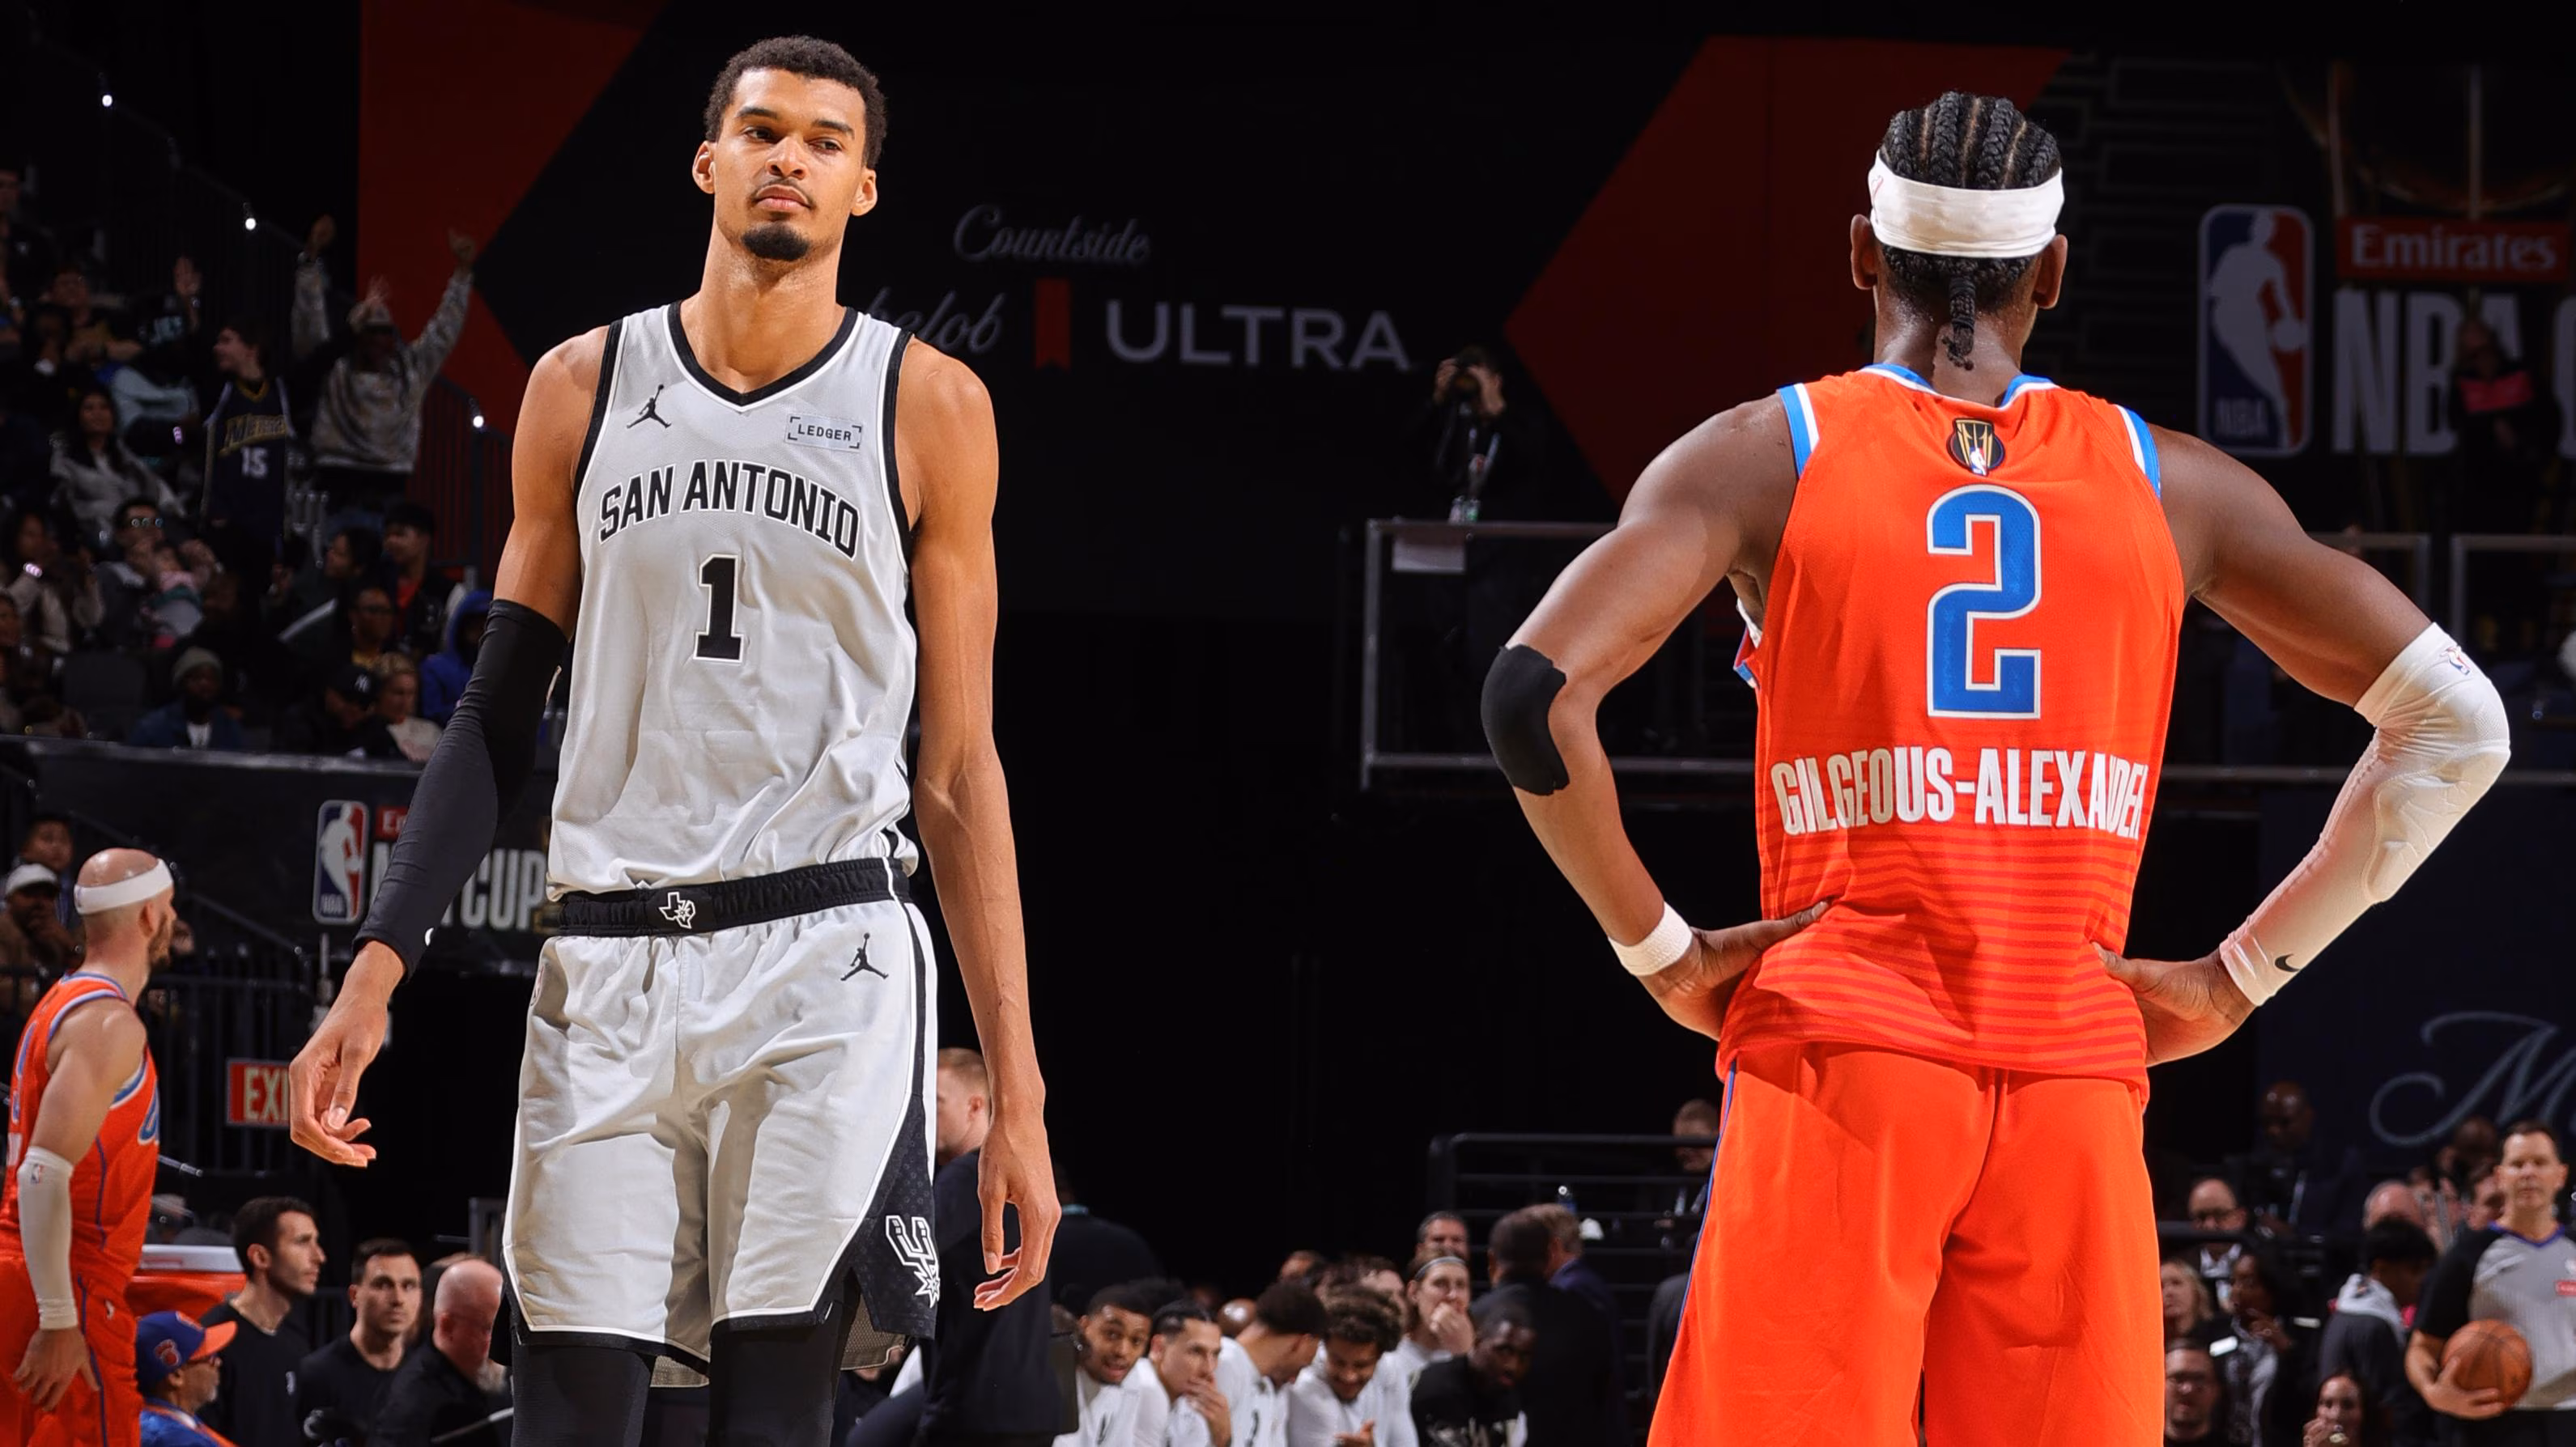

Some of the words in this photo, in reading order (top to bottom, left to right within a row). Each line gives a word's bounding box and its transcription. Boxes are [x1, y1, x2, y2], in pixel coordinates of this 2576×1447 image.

[953, 202, 1152, 265] Courtside
[2350, 223, 2558, 273] Emirates
[1105, 298, 1412, 372] ULTRA
[240, 445, 270, 479] 15
[797, 423, 852, 442] LEDGER
[599, 464, 675, 545] SAN
[679, 459, 860, 562] ANTONIO
[693, 553, 744, 664] 1
[1927, 484, 2042, 719] 2
[460, 847, 546, 931] CUP
[244, 1067, 291, 1122] EXI
